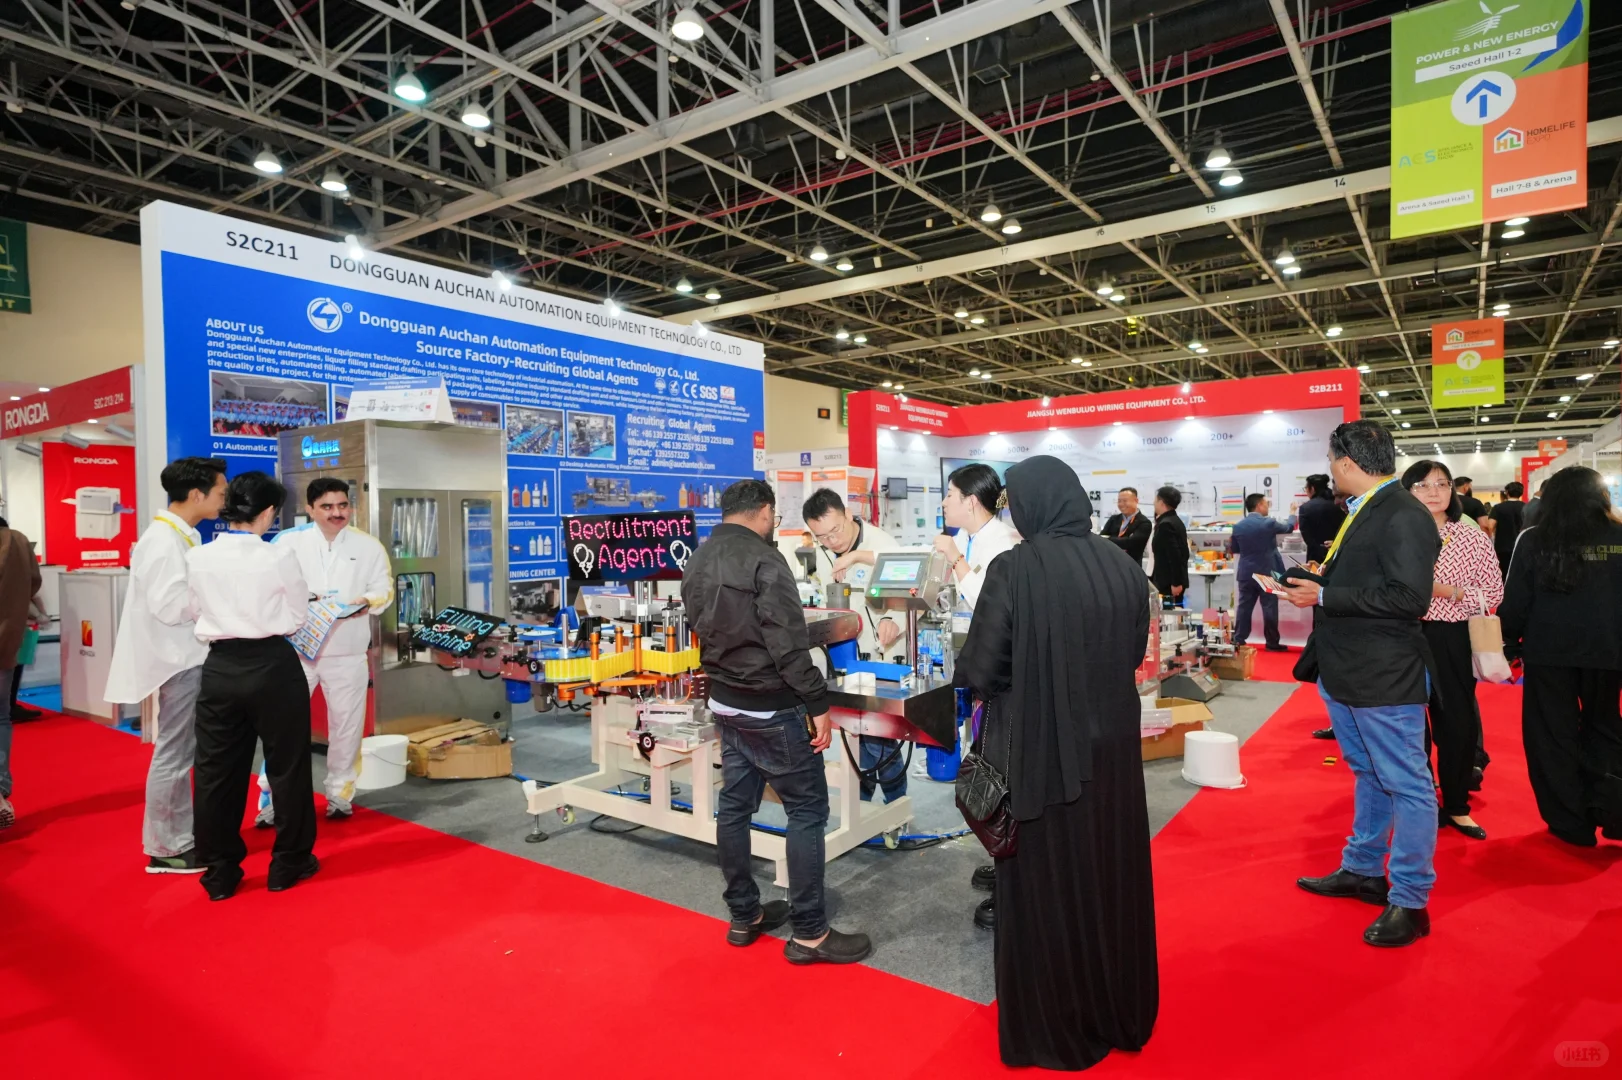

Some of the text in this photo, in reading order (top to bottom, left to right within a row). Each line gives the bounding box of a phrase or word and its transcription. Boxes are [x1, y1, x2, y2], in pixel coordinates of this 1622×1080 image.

[1416, 48, 1460, 64] POWER
[1474, 36, 1503, 50] NEW
[1506, 21, 1558, 42] ENERGY
[1449, 48, 1522, 72] Saeed Hall 1-2
[1526, 120, 1576, 136] HOMELIFE
[1527, 134, 1550, 145] EXPO
[1334, 178, 1346, 187] 14
[1496, 185, 1514, 194] Hall
[1543, 175, 1572, 184] Arena
[1206, 205, 1216, 214] 15
[1400, 203, 1420, 211] Arena
[1428, 198, 1450, 206] Saeed
[226, 231, 298, 261] S2C211
[330, 254, 742, 356] DONGGUAN AUCHAN AUTOMATION EQUIPMENT TECHNOLOGY CO., LTD
[206, 318, 264, 335] ABOUT US
[206, 330, 252, 342] Dongguan
[254, 336, 286, 347] Auchan
[287, 341, 332, 354] Automation
[334, 348, 372, 360] Equipment
[373, 354, 411, 366] Technology
[425, 360, 437, 368] Ltd.
[485, 370, 516, 380] technology
[360, 311, 700, 382] Dongguan Auchan Automation Equipment Technology Co., Ltd.
[207, 340, 224, 348] and
[226, 342, 257, 352] special
[258, 347, 276, 355] new
[278, 350, 324, 362] enterprises,
[325, 355, 346, 364] liquor
[348, 358, 368, 368] filling
[370, 362, 400, 372] standard
[400, 366, 426, 376] drafting
[208, 350, 254, 362] production
[256, 355, 278, 366] lines,
[280, 358, 322, 370] automated
[324, 364, 348, 374] filling,
[349, 368, 387, 378] automated
[416, 340, 639, 386] Source Factory-Recruiting Global Agents
[208, 358, 223, 366] the
[224, 361, 254, 372] quality
[281, 368, 312, 378] project,
[450, 389, 470, 397] supply
[700, 385, 718, 400] SGS
[1309, 384, 1343, 394] S2B211
[5, 401, 50, 430] RONGDA
[1027, 395, 1206, 418] JIANGSU WENBULUO WIRING EQUIPMENT CO., LTD.
[627, 414, 716, 433] Recruiting Global Agents
[628, 428, 639, 436] Tel:
[1286, 428, 1306, 436] 80+
[225, 443, 268, 452] Automatic
[628, 438, 659, 449] WhatsApp:
[1142, 437, 1173, 445] 10000+
[628, 448, 652, 456] WeChat:
[628, 458, 649, 466] E-mail:
[569, 514, 692, 540] Recruitment
[598, 544, 667, 574] Agent
[510, 568, 556, 578] INING CENTER
[436, 609, 494, 636] Filling
[412, 626, 472, 652] Machine
